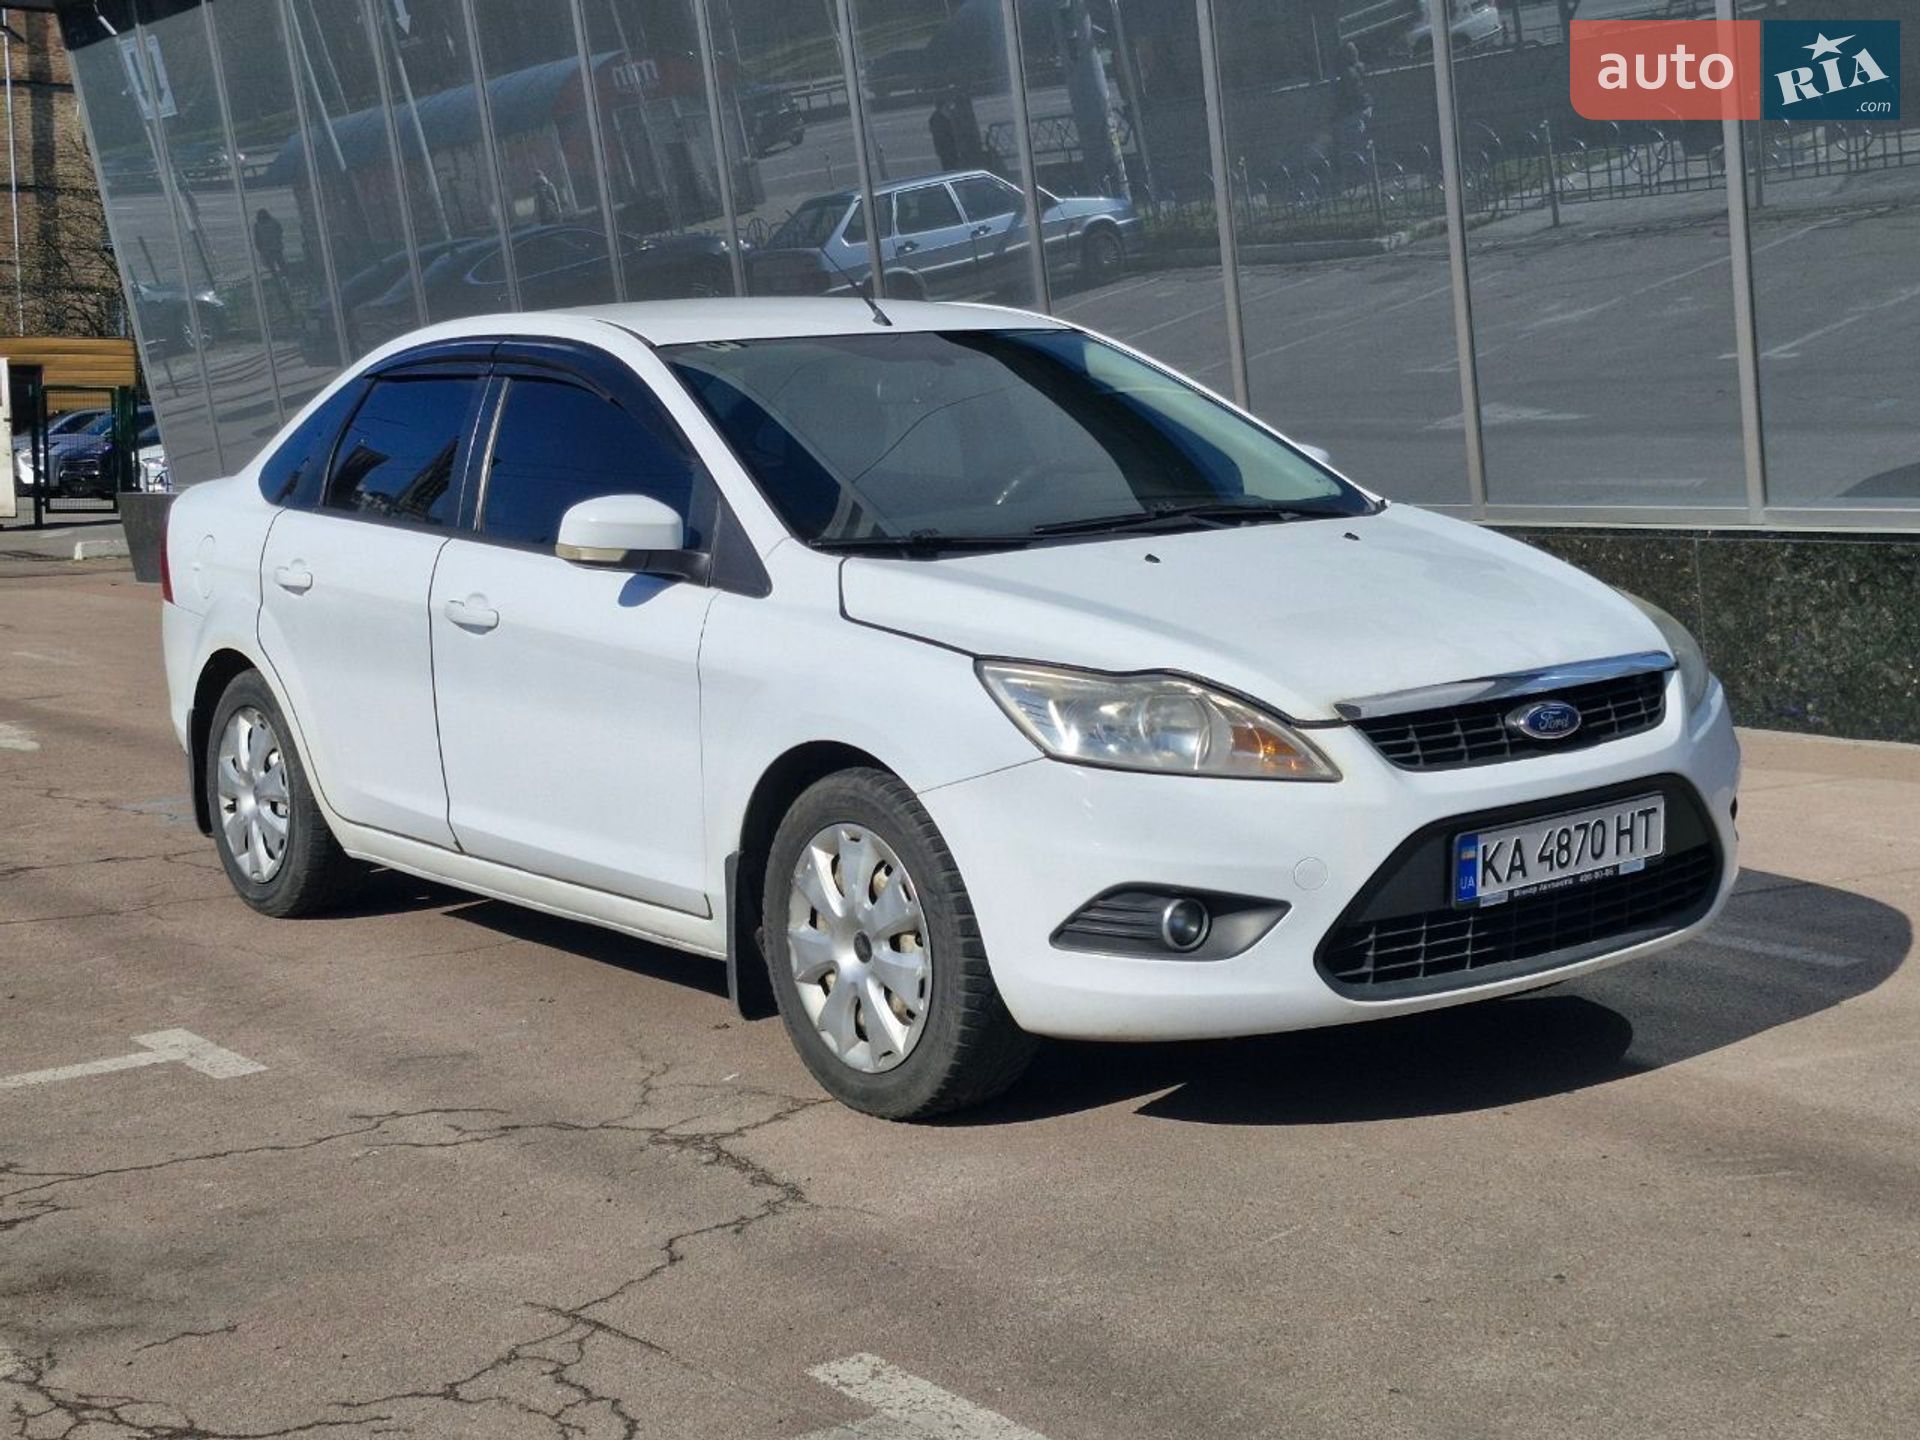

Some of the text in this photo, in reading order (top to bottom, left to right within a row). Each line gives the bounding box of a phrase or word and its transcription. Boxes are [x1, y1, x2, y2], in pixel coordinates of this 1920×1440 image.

[1539, 711, 1569, 730] Ford
[1481, 838, 1527, 887] KA
[1537, 818, 1606, 872] 4870
[1614, 807, 1657, 856] HT
[1460, 876, 1475, 890] UA
